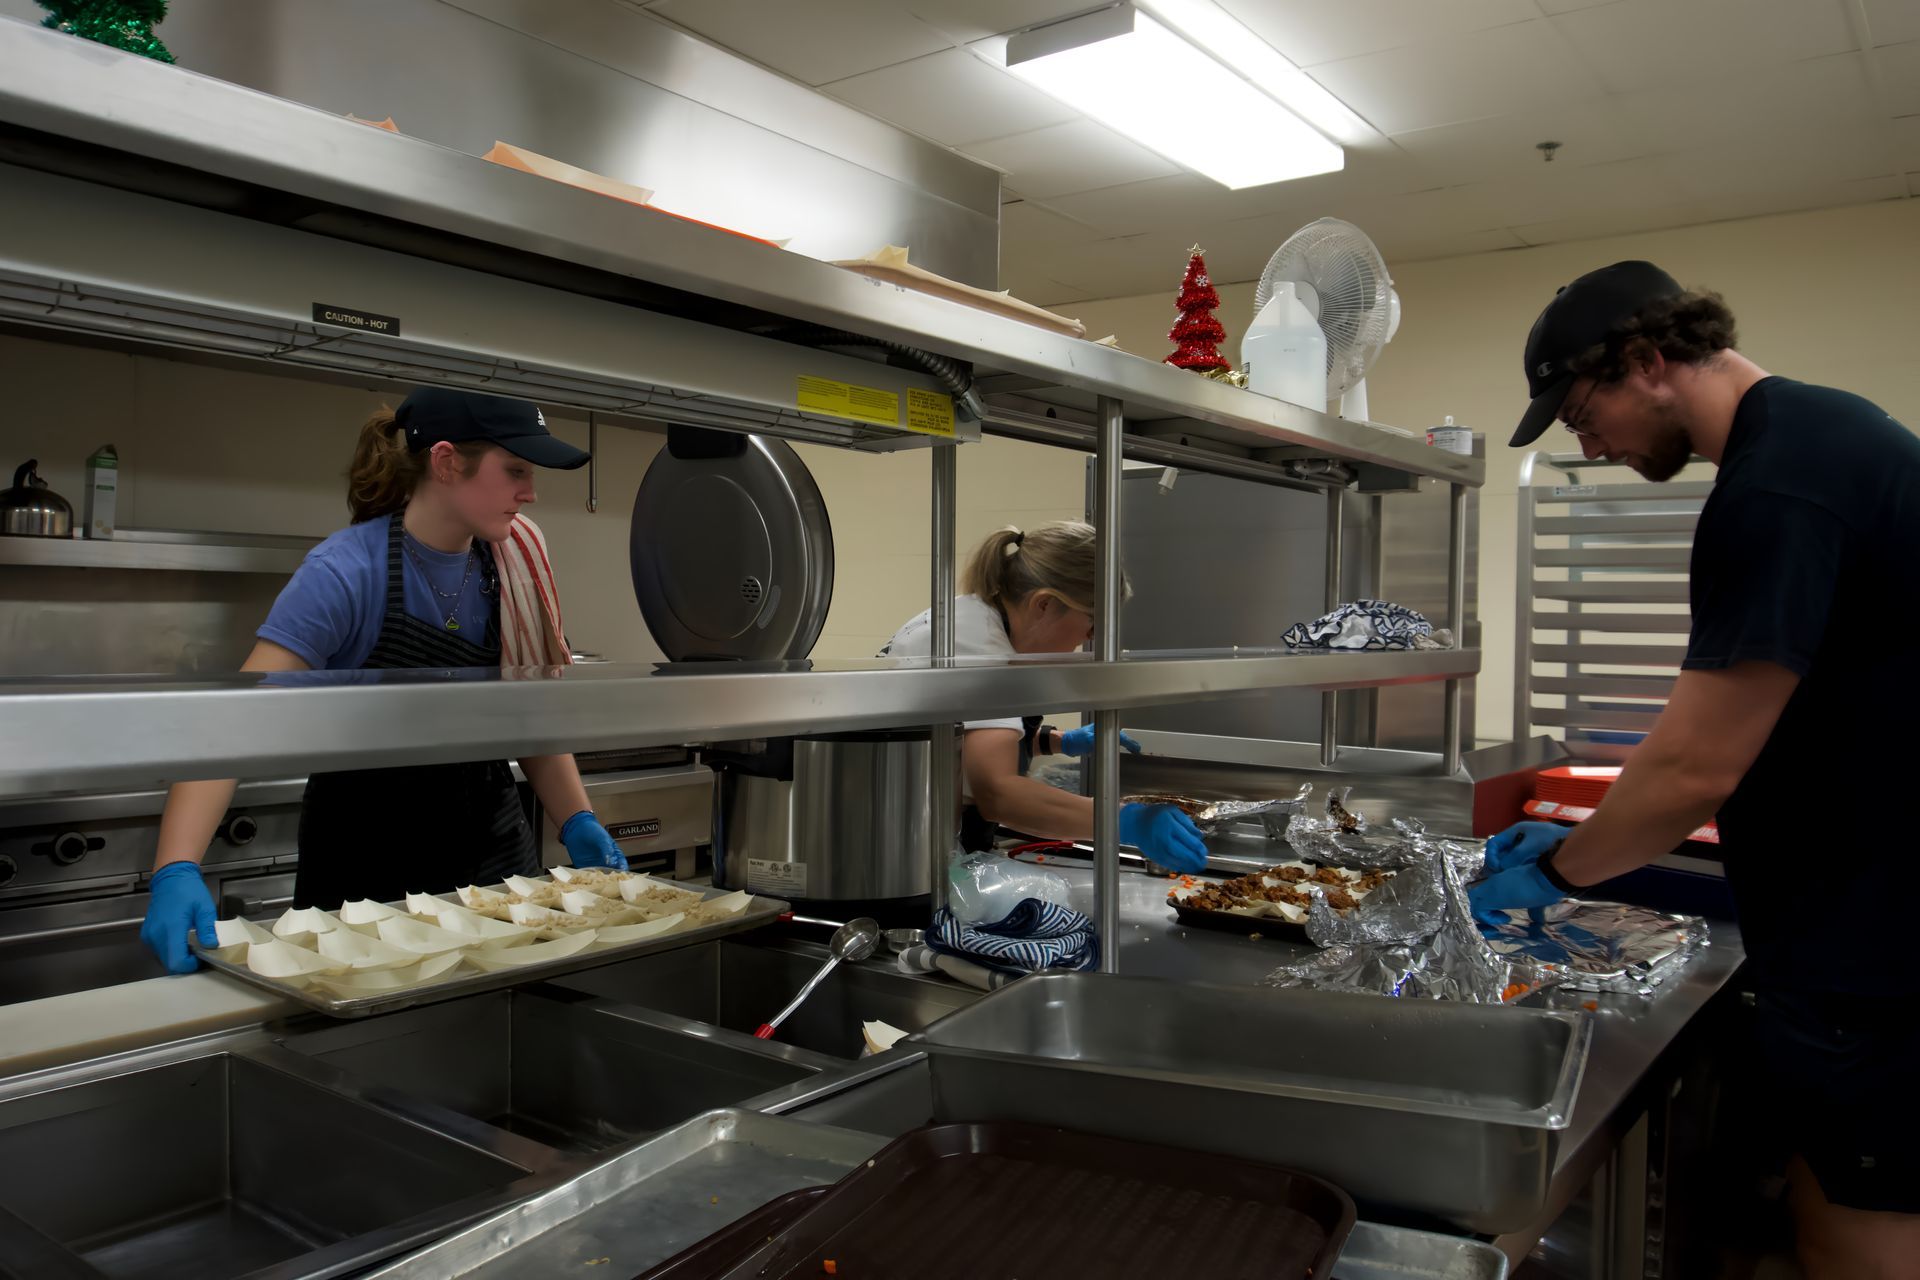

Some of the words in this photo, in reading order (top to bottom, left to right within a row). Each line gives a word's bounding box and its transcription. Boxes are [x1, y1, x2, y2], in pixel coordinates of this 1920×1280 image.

[325, 311, 364, 326] CAUTION
[370, 319, 389, 330] HOT
[618, 823, 658, 836] GARLAND
